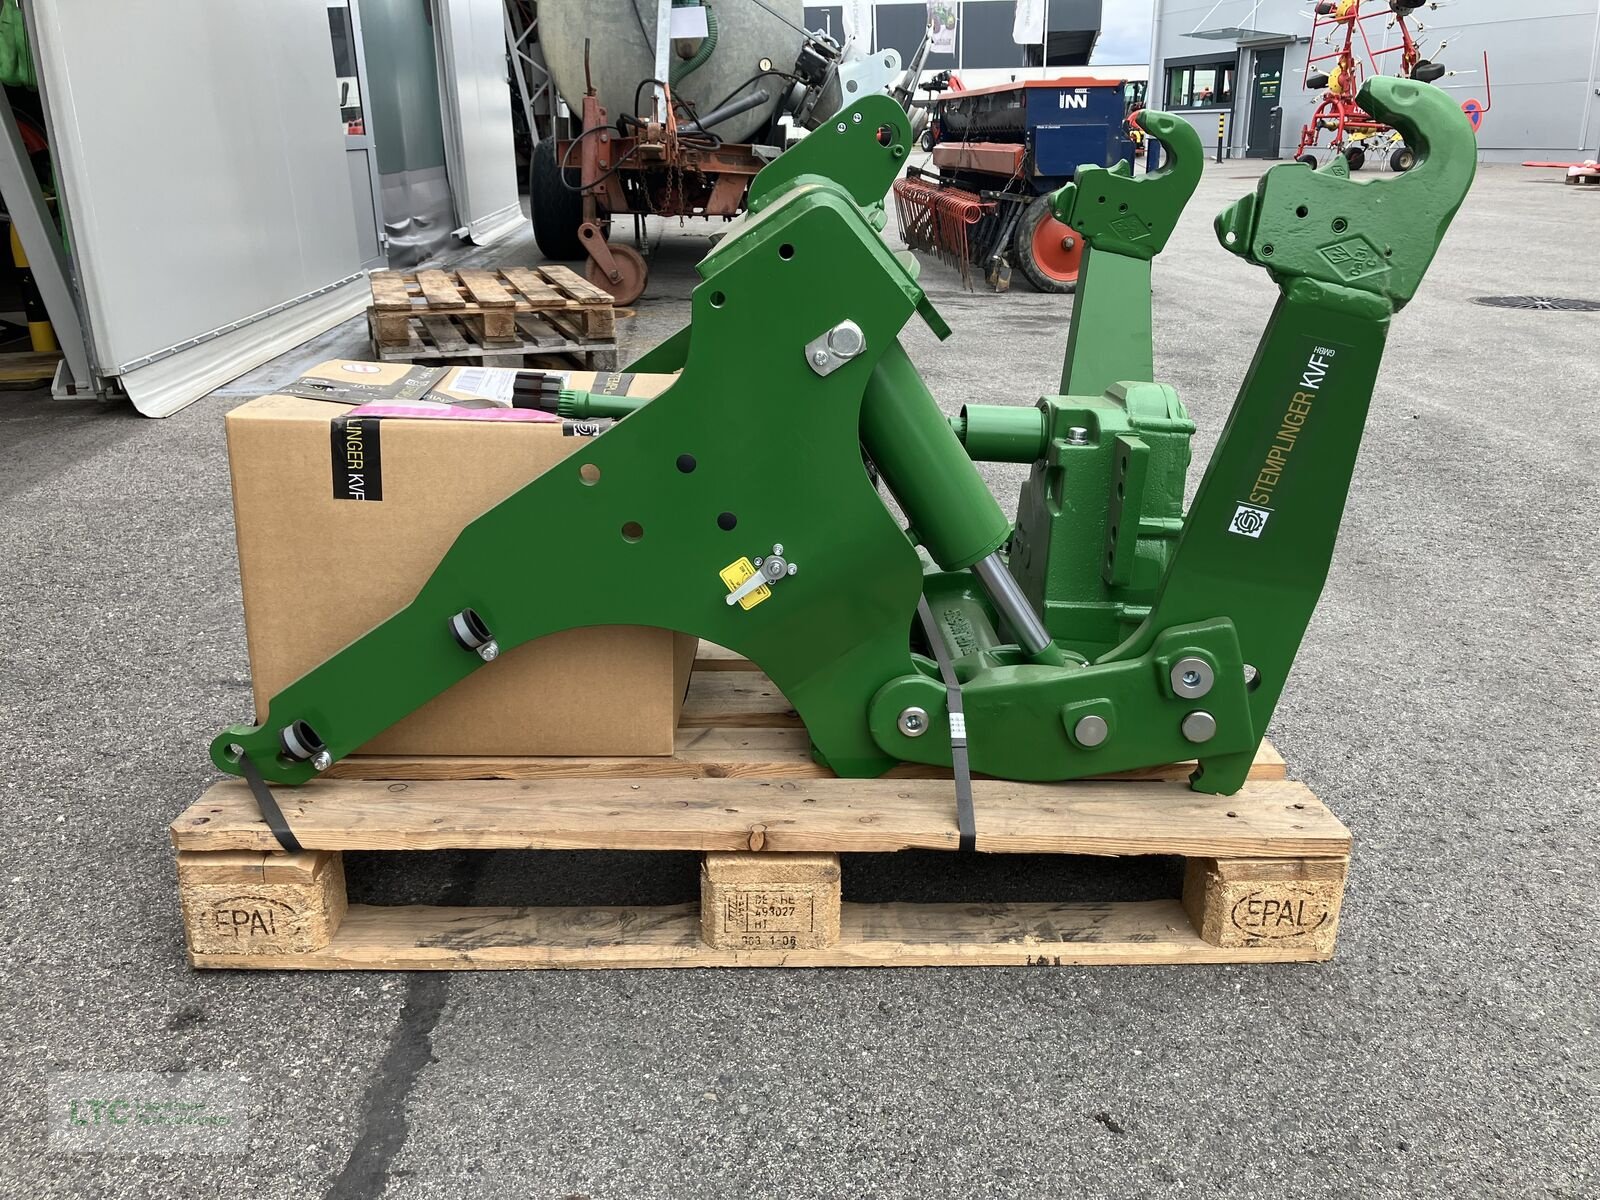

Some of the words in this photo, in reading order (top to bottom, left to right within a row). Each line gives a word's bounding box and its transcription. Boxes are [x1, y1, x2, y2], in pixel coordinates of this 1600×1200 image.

[346, 418, 364, 470] LINGER
[1249, 391, 1316, 504] STEMPLINGER
[1299, 353, 1330, 390] KVF
[347, 473, 365, 500] KVF
[1246, 900, 1308, 926] EPAL
